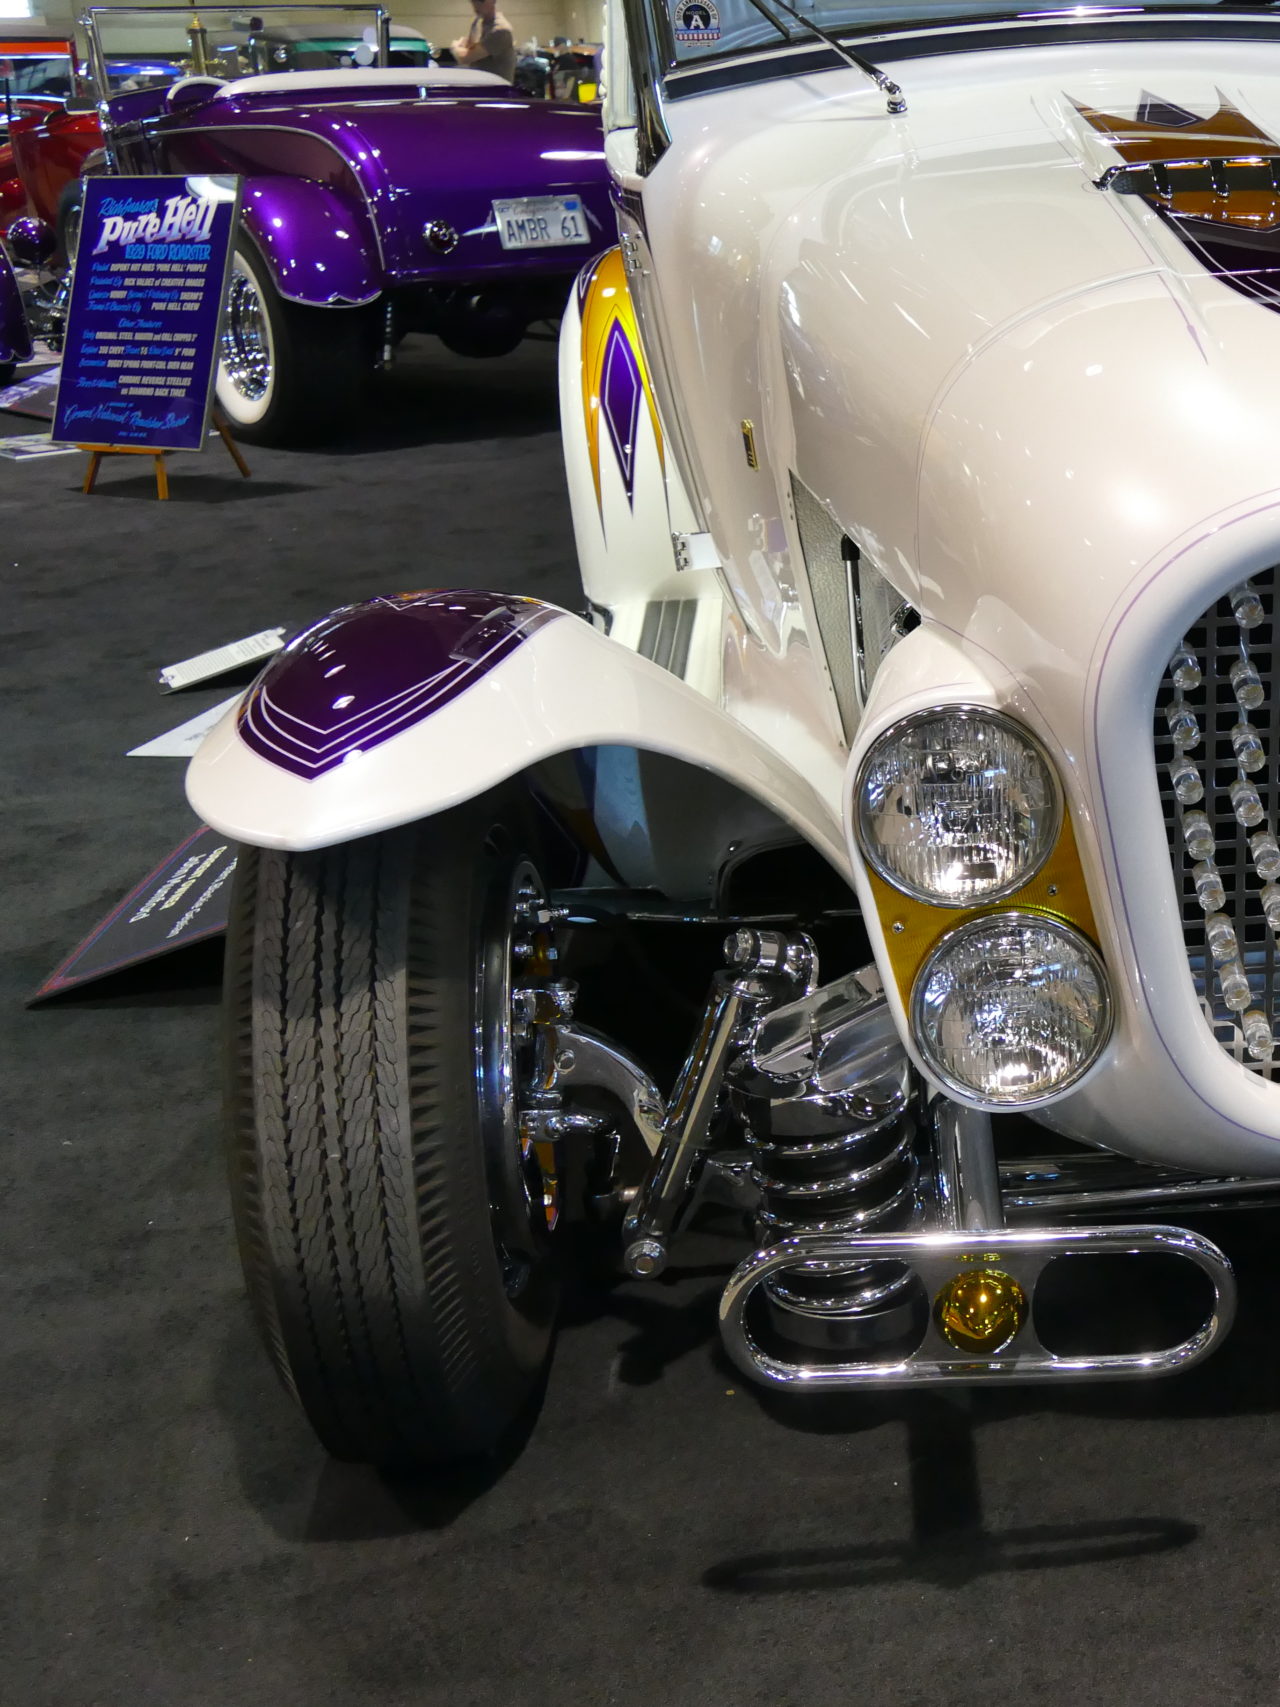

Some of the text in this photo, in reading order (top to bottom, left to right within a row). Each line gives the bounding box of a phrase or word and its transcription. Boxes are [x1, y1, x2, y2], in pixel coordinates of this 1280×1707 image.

[690, 15, 705, 29] A
[92, 195, 218, 254] Pure Hell
[506, 215, 583, 243] AMBR 61
[146, 244, 168, 259] FORD
[168, 244, 211, 259] ROADSTER
[152, 302, 167, 310] PURE
